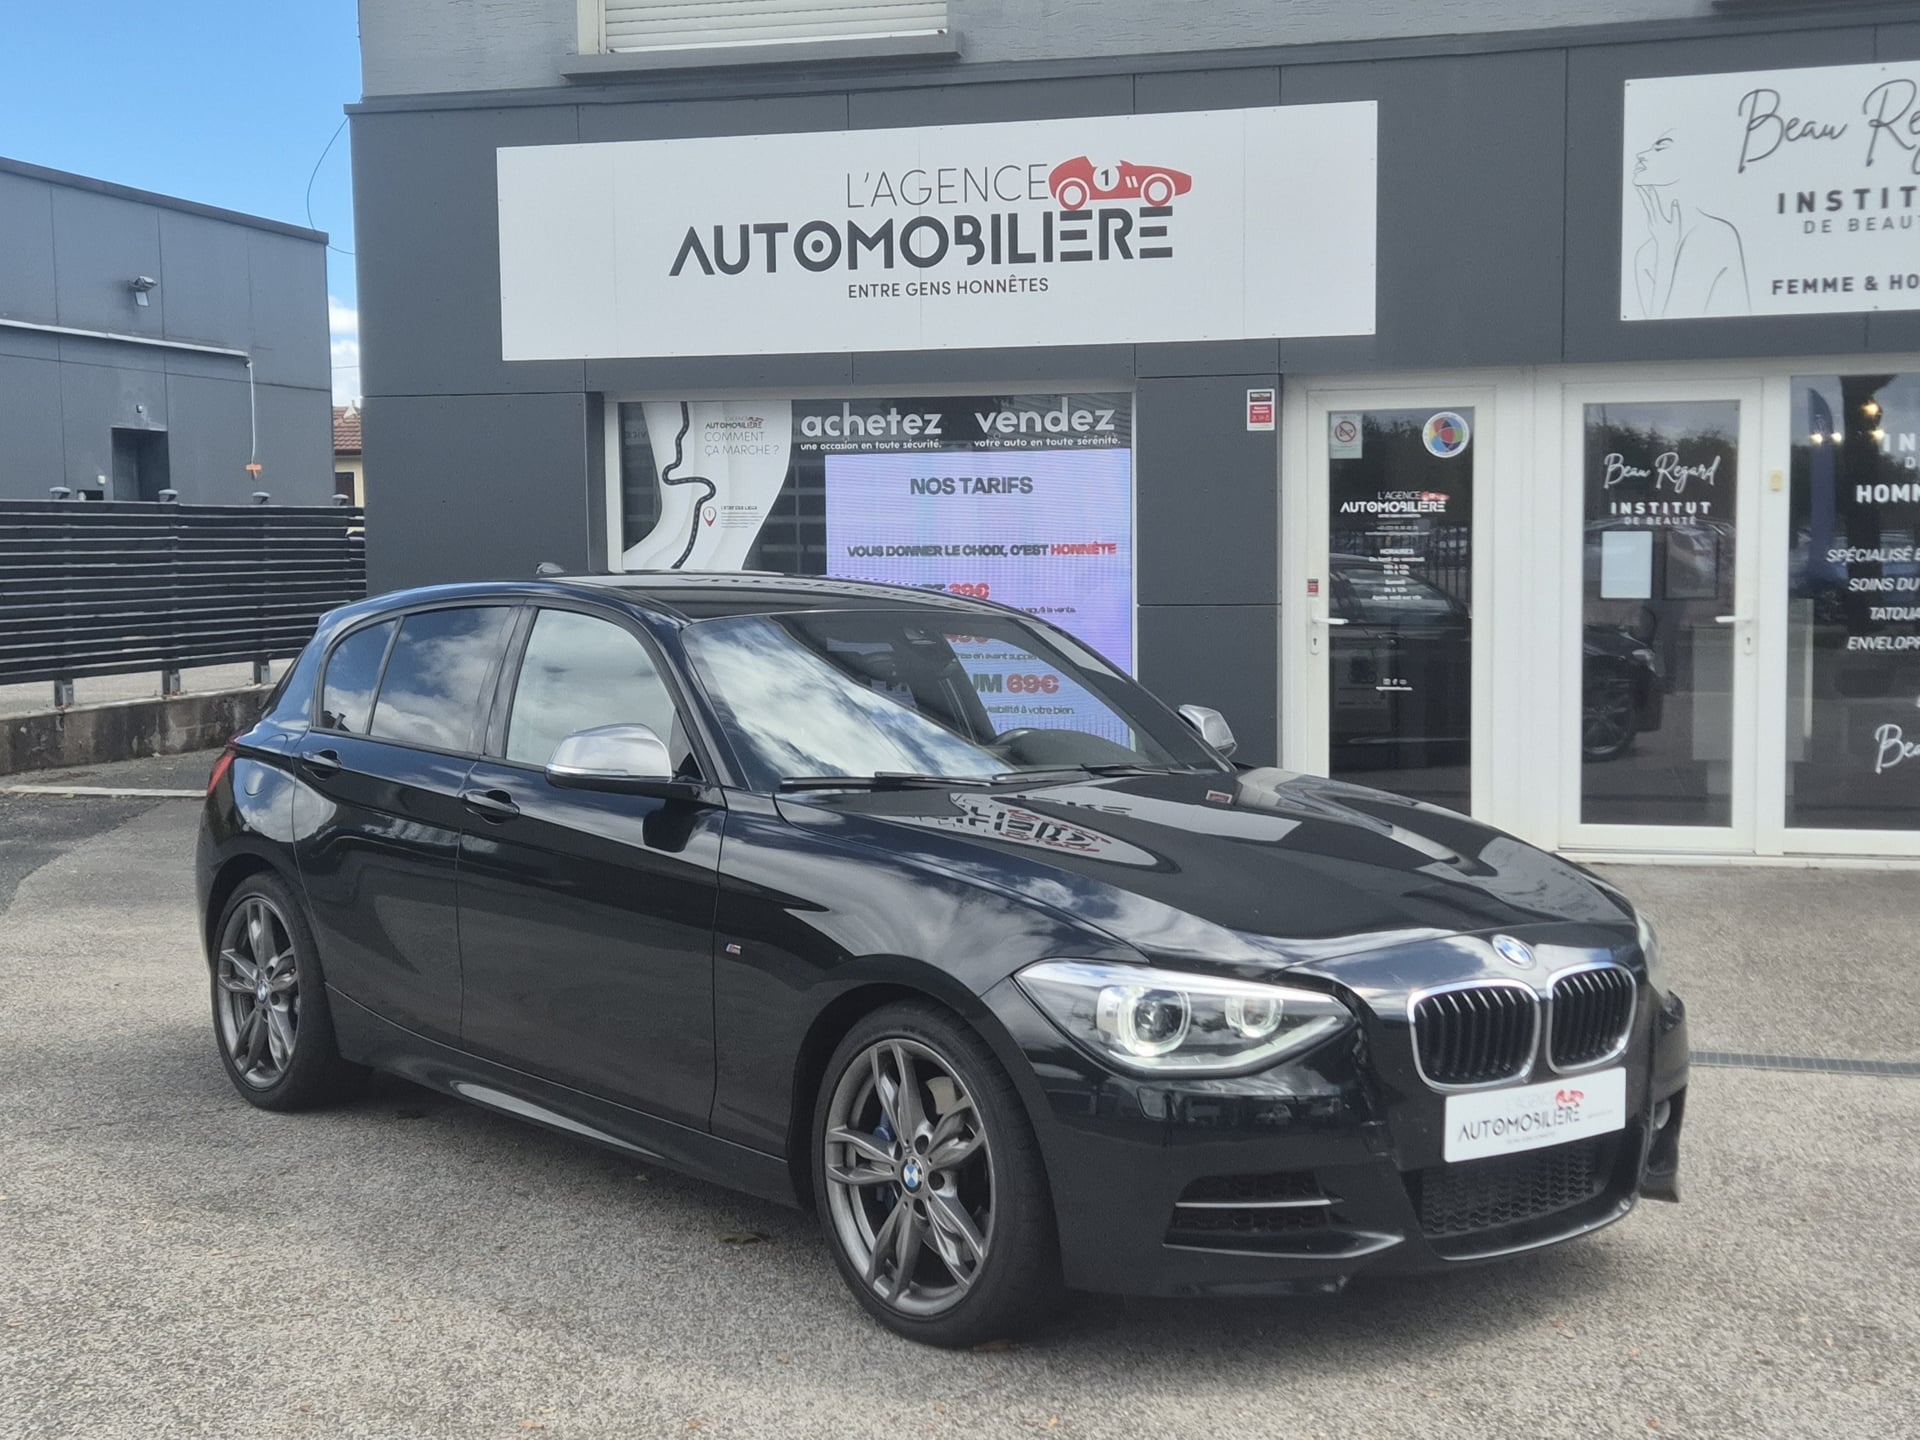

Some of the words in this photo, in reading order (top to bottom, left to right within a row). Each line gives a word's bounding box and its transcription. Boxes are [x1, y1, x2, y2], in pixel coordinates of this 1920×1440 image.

[1738, 88, 1848, 174] Beau
[1862, 78, 1920, 175] Re
[847, 163, 1049, 208] L'AGENCE
[1099, 168, 1111, 187] 1
[1776, 185, 1918, 215] INSTIT
[1803, 218, 1832, 235] DE
[1848, 214, 1920, 233] BEAU
[848, 282, 901, 299] ENTRE
[905, 280, 951, 297] GENS
[956, 273, 1049, 295] HONNÊTES
[1771, 276, 1854, 296] FEMME
[1864, 275, 1879, 291] &
[800, 401, 942, 437] achetez
[974, 396, 1116, 433] vendez
[704, 431, 765, 442] COMMENT
[800, 442, 818, 451] une
[820, 440, 857, 450] occasion
[861, 441, 872, 449] en
[875, 439, 900, 449] toute
[974, 437, 1000, 448] votre
[1003, 438, 1027, 447] auto
[1030, 439, 1043, 447] en
[1046, 436, 1073, 447] toute
[704, 445, 719, 457] ÇA
[722, 444, 770, 456] MARCHE
[773, 444, 780, 456] ?
[1603, 453, 1651, 489] Beau
[1654, 451, 1721, 494] Regard
[910, 477, 956, 496] NOS
[958, 475, 1034, 495] TARIFS
[1377, 491, 1420, 501] L'AGENCE
[1610, 501, 1712, 515] INSTITUT
[1624, 517, 1640, 525] DE
[847, 545, 885, 558] VOUS
[885, 545, 943, 557] DONNER
[944, 544, 961, 556] LE
[1050, 540, 1117, 556] HONNÊTE
[1825, 545, 1913, 562] SPÉCIALISÉ
[1847, 577, 1895, 592] SOINS
[1006, 673, 1060, 694] 69€
